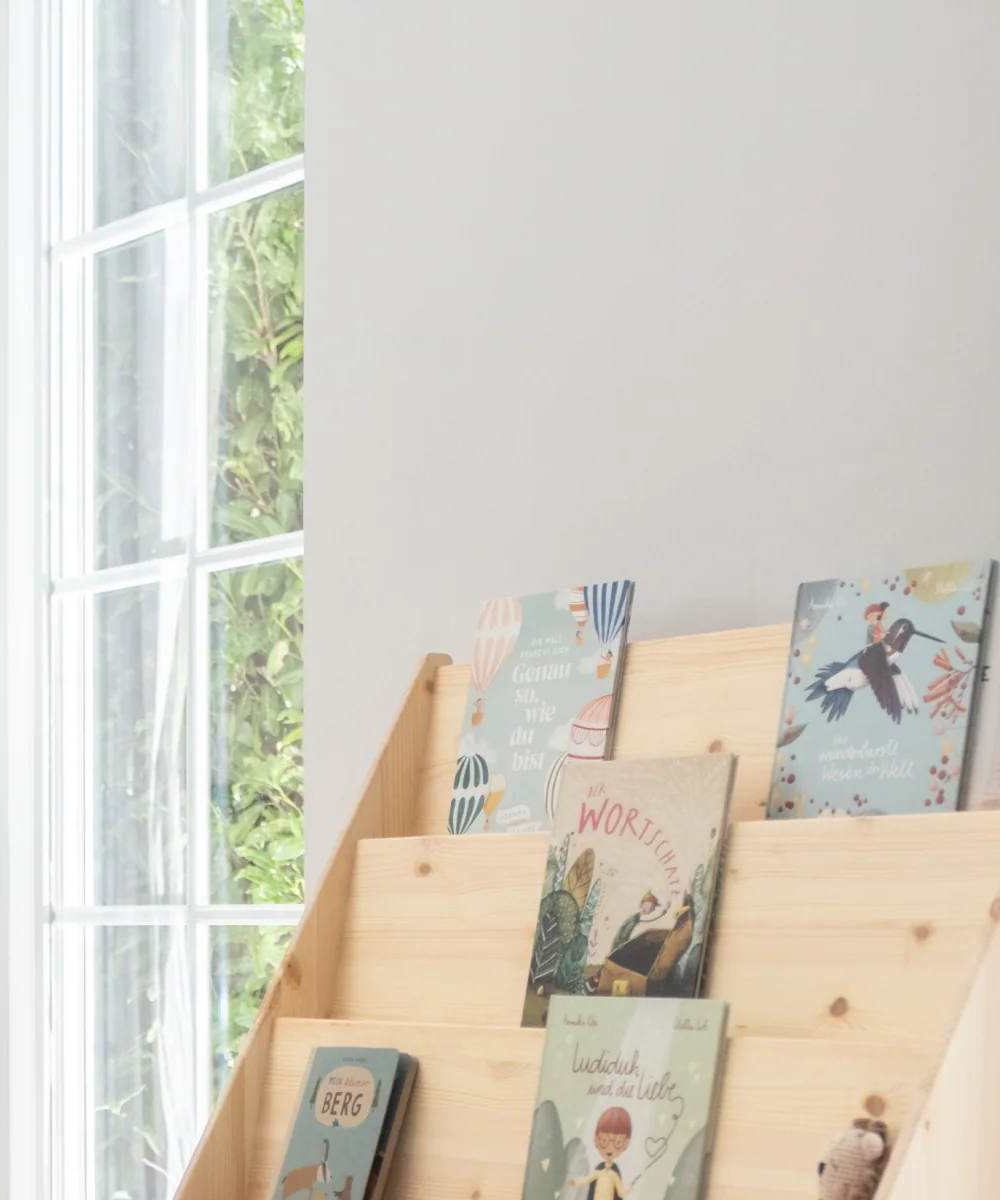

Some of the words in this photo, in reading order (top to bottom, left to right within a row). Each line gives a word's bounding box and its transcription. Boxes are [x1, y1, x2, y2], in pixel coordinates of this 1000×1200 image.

[512, 662, 572, 684] Genau
[525, 701, 556, 723] wie
[510, 726, 534, 746] du
[511, 749, 544, 771] bist
[588, 783, 606, 798] DER
[572, 1041, 639, 1077] Ludiduh
[587, 1080, 613, 1097] und
[615, 1079, 635, 1098] die
[321, 1091, 364, 1117] BERG
